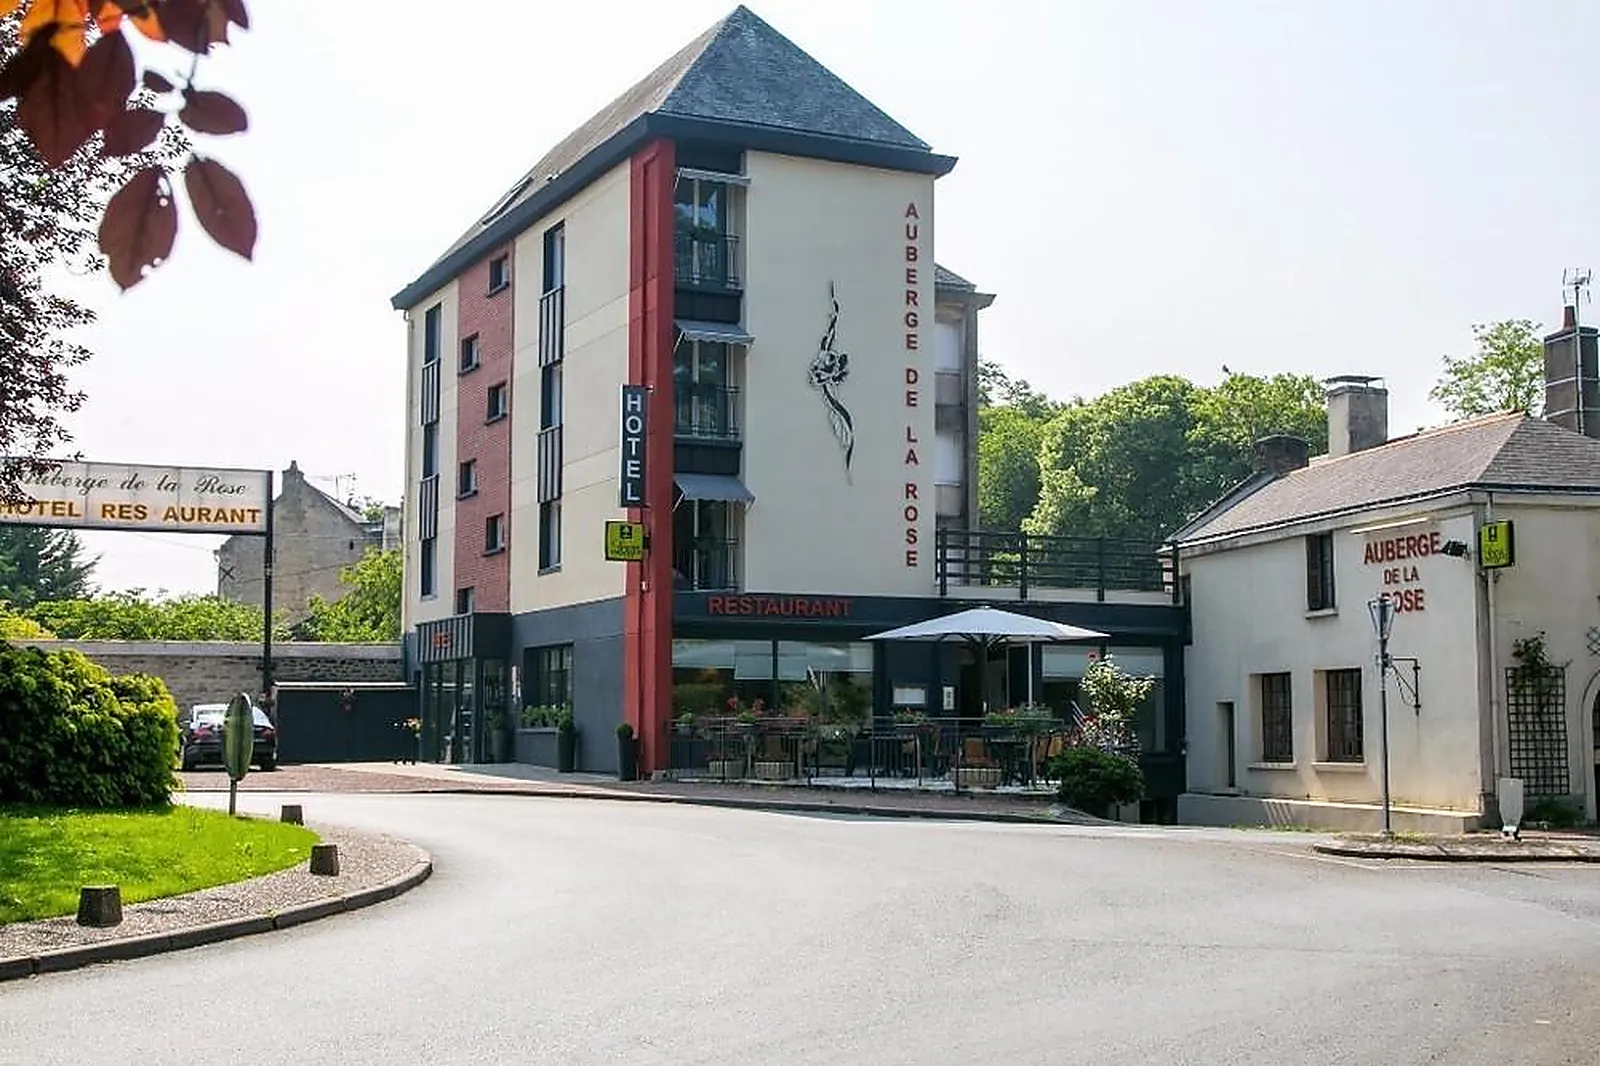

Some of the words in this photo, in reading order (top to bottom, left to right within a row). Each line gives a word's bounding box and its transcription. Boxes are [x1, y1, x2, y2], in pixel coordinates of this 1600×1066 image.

[905, 202, 920, 350] AUBERGE
[905, 368, 919, 407] DE
[625, 393, 643, 502] HOTEL
[905, 426, 919, 465] LA
[119, 472, 146, 491] de
[156, 474, 179, 492] la
[193, 474, 247, 495] Rose
[904, 483, 919, 567] ROSE
[1363, 531, 1441, 565] AUBERGE
[1383, 568, 1401, 584] DE
[1403, 565, 1420, 582] LA
[708, 595, 853, 616] RESTAURANT
